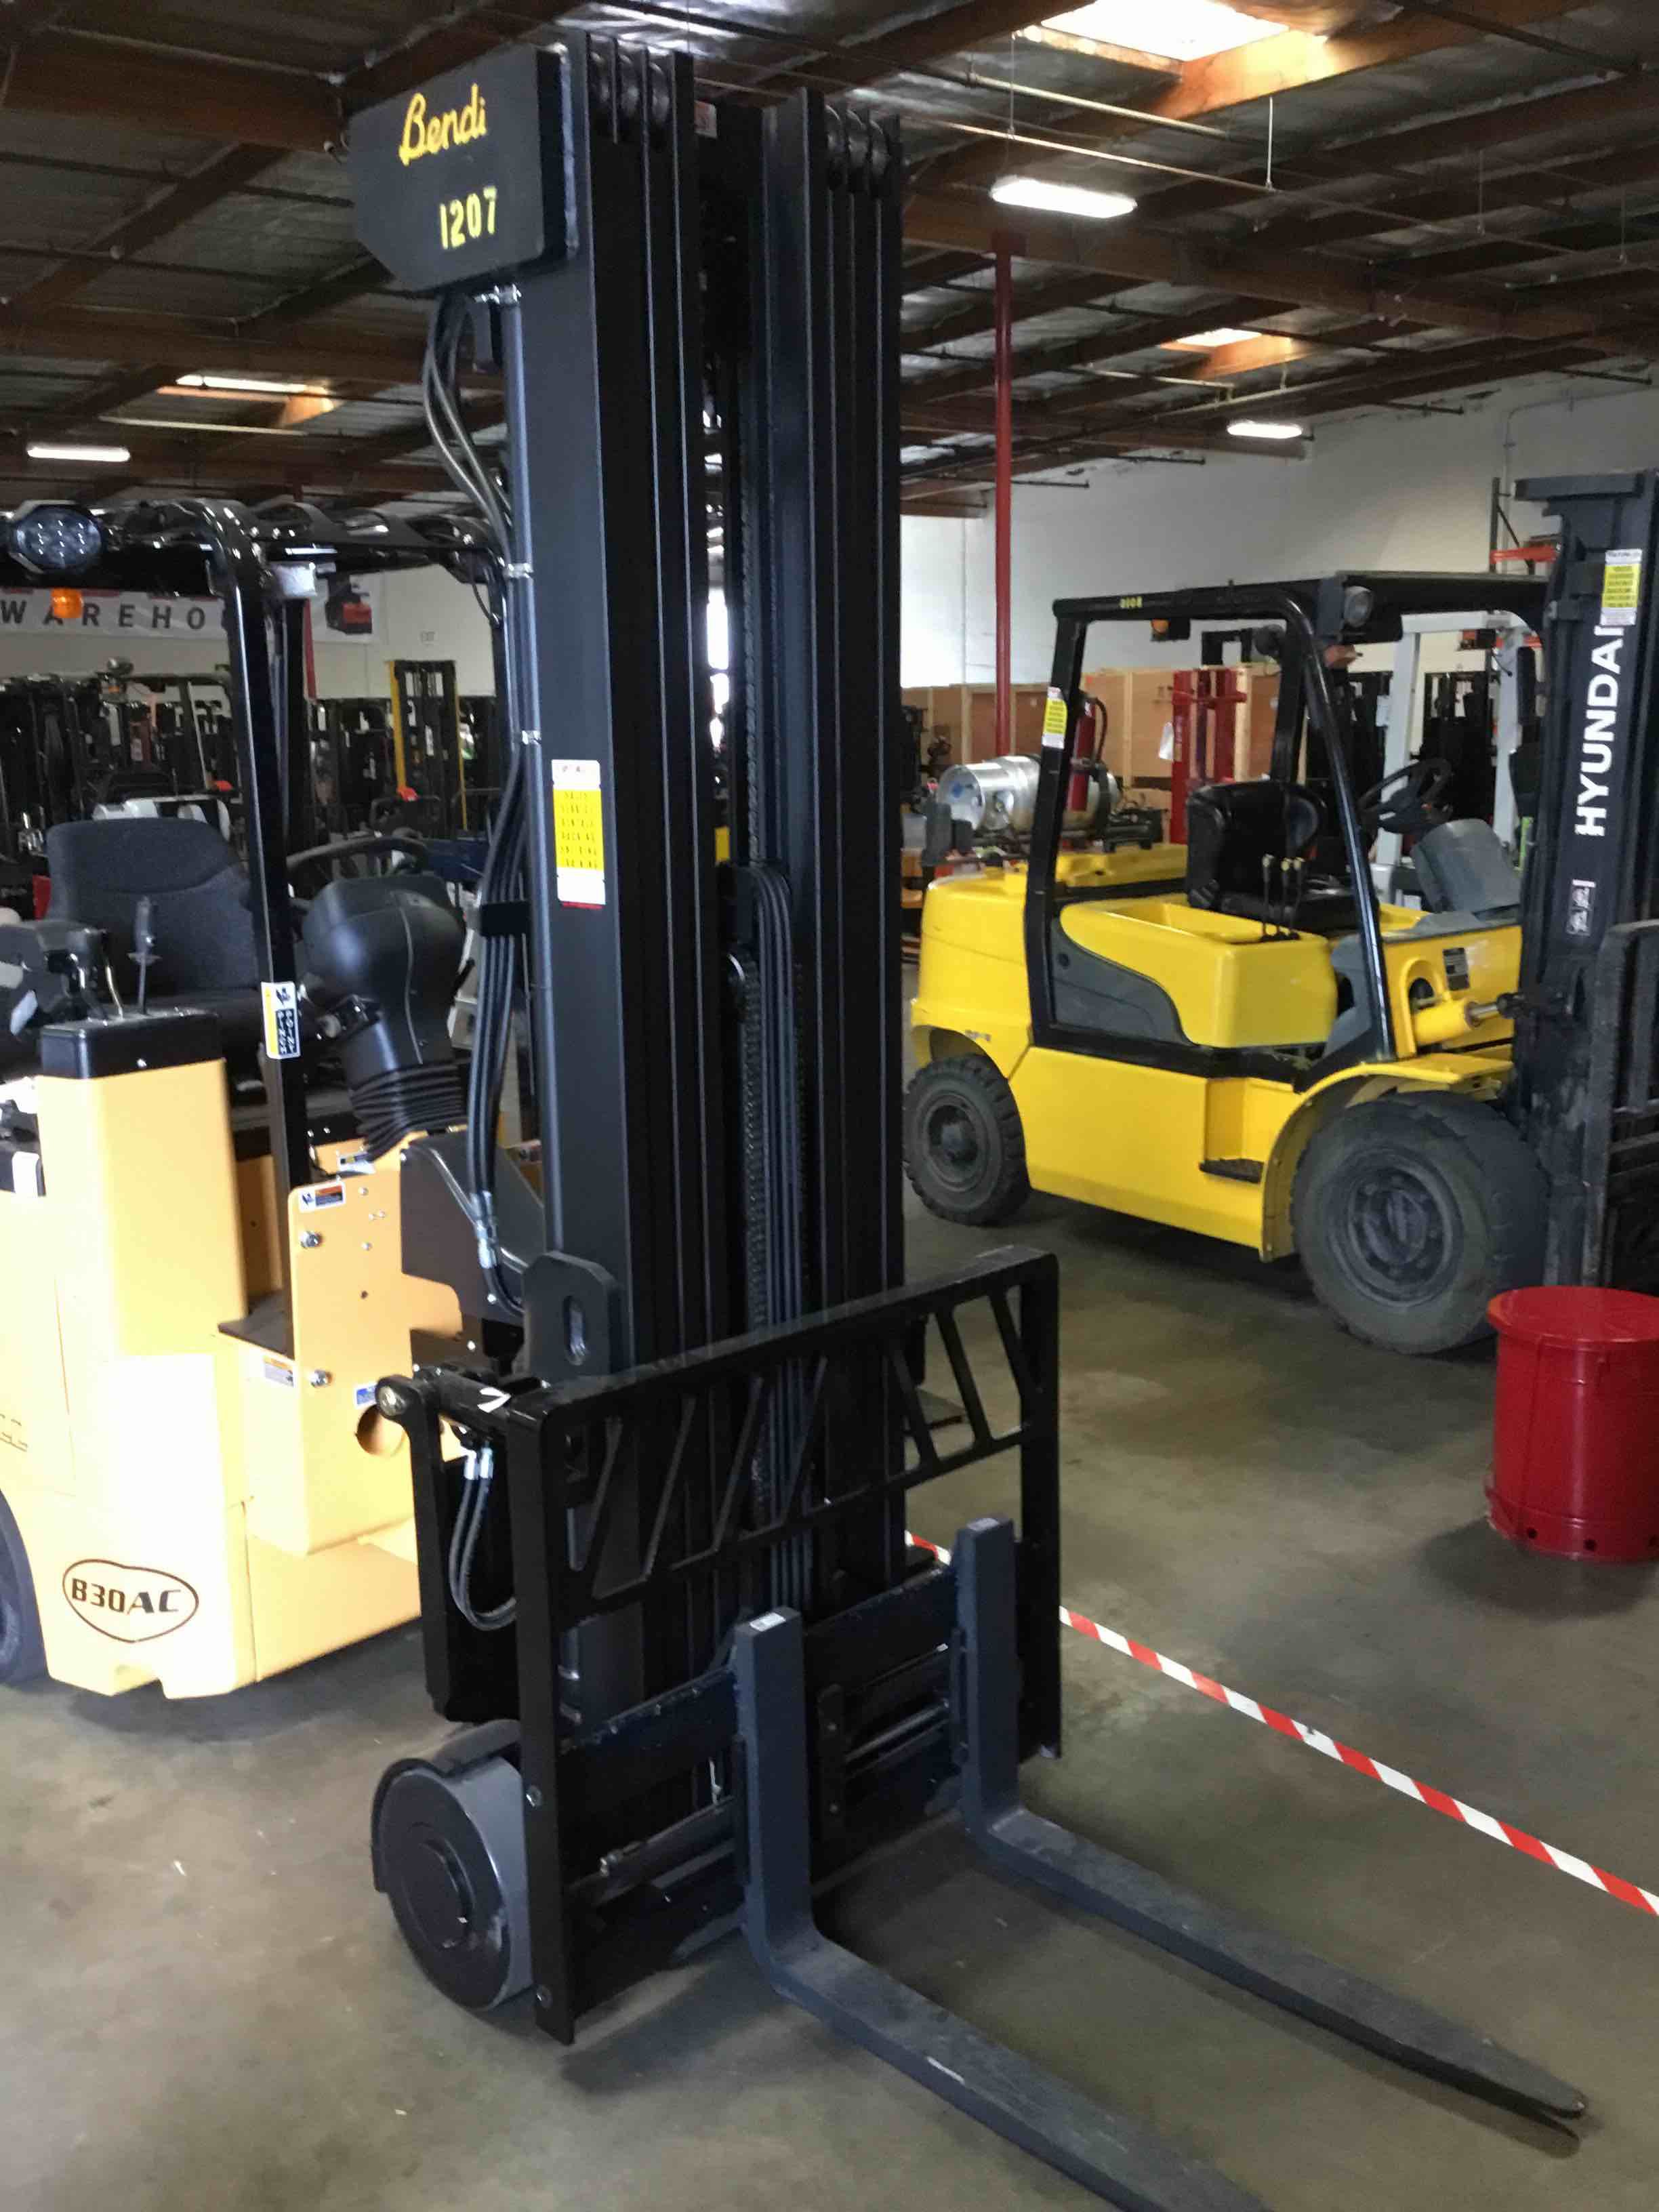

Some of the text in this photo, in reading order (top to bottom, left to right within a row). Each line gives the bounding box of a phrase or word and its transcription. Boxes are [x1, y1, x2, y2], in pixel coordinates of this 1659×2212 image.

[398, 83, 487, 165] Bendi
[439, 185, 498, 250] 1207
[1, 599, 227, 630] WAREHO
[1574, 625, 1625, 837] HYUNDAI
[71, 1578, 182, 1615] B30AC
